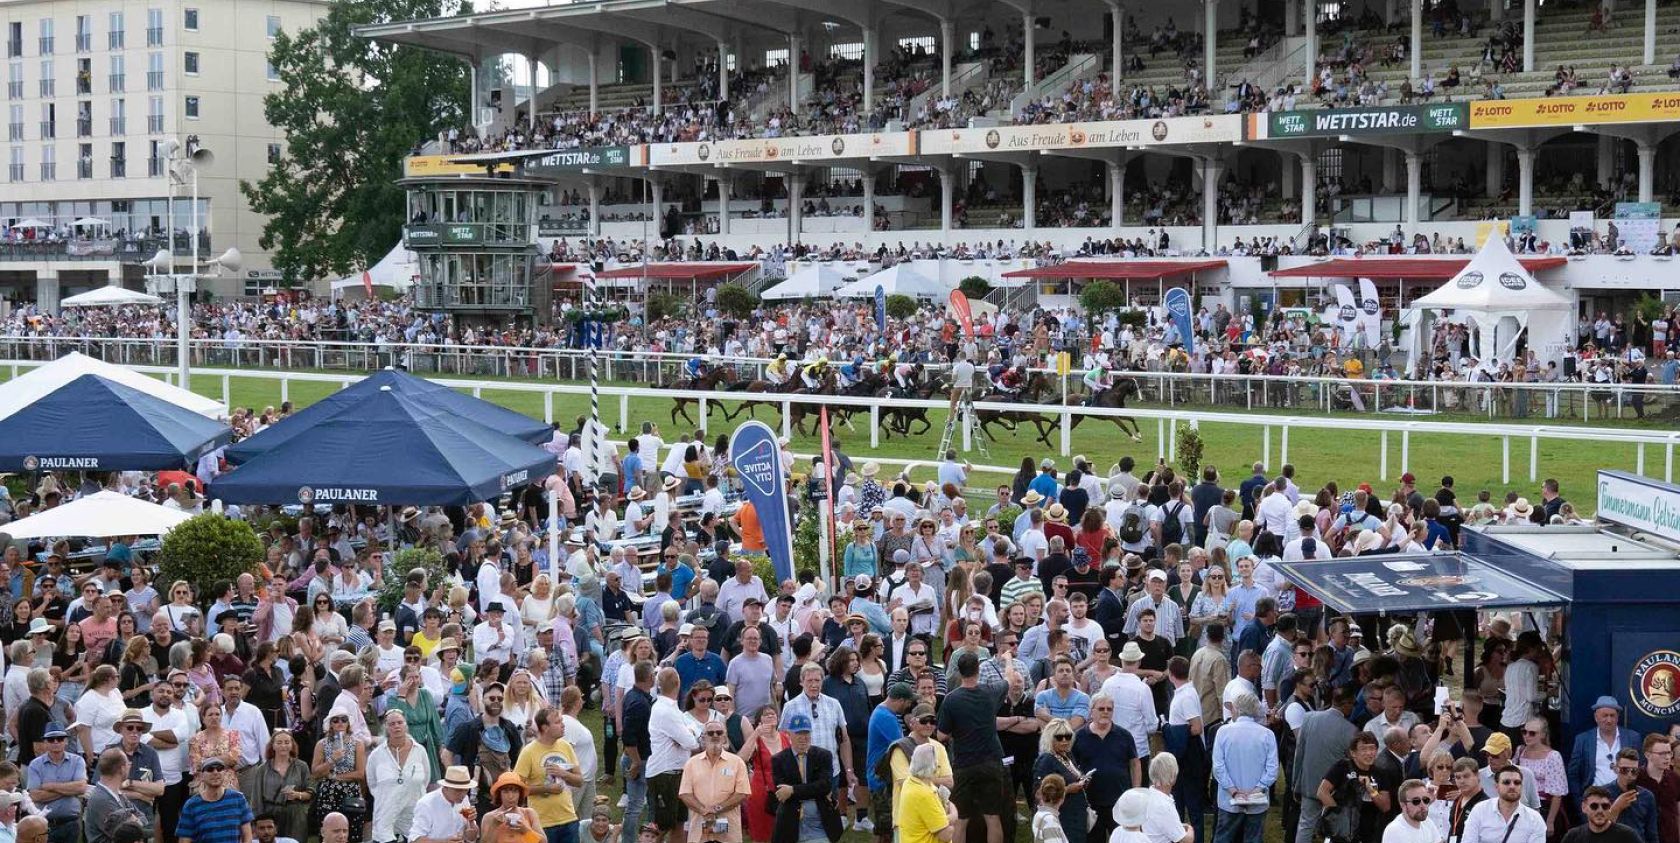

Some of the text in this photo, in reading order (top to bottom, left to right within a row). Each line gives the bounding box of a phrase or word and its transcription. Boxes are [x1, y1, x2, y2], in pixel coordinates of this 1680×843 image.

[1485, 106, 1512, 116] LOTTO
[1547, 104, 1575, 114] LOTTO
[1597, 101, 1625, 111] LOTTO
[1429, 107, 1454, 118] WETT
[1279, 115, 1301, 126] WETT
[1316, 111, 1417, 130] WETTSTAR.de
[1435, 116, 1458, 127] STAR
[1284, 122, 1304, 133] STAR
[1008, 130, 1140, 147] Aus Freude am Leben
[716, 144, 822, 159] Aus Freude am Leben
[541, 152, 600, 166] WETTSTAR.de
[40, 457, 99, 468] PAULANER
[314, 488, 378, 501] PAULANER
